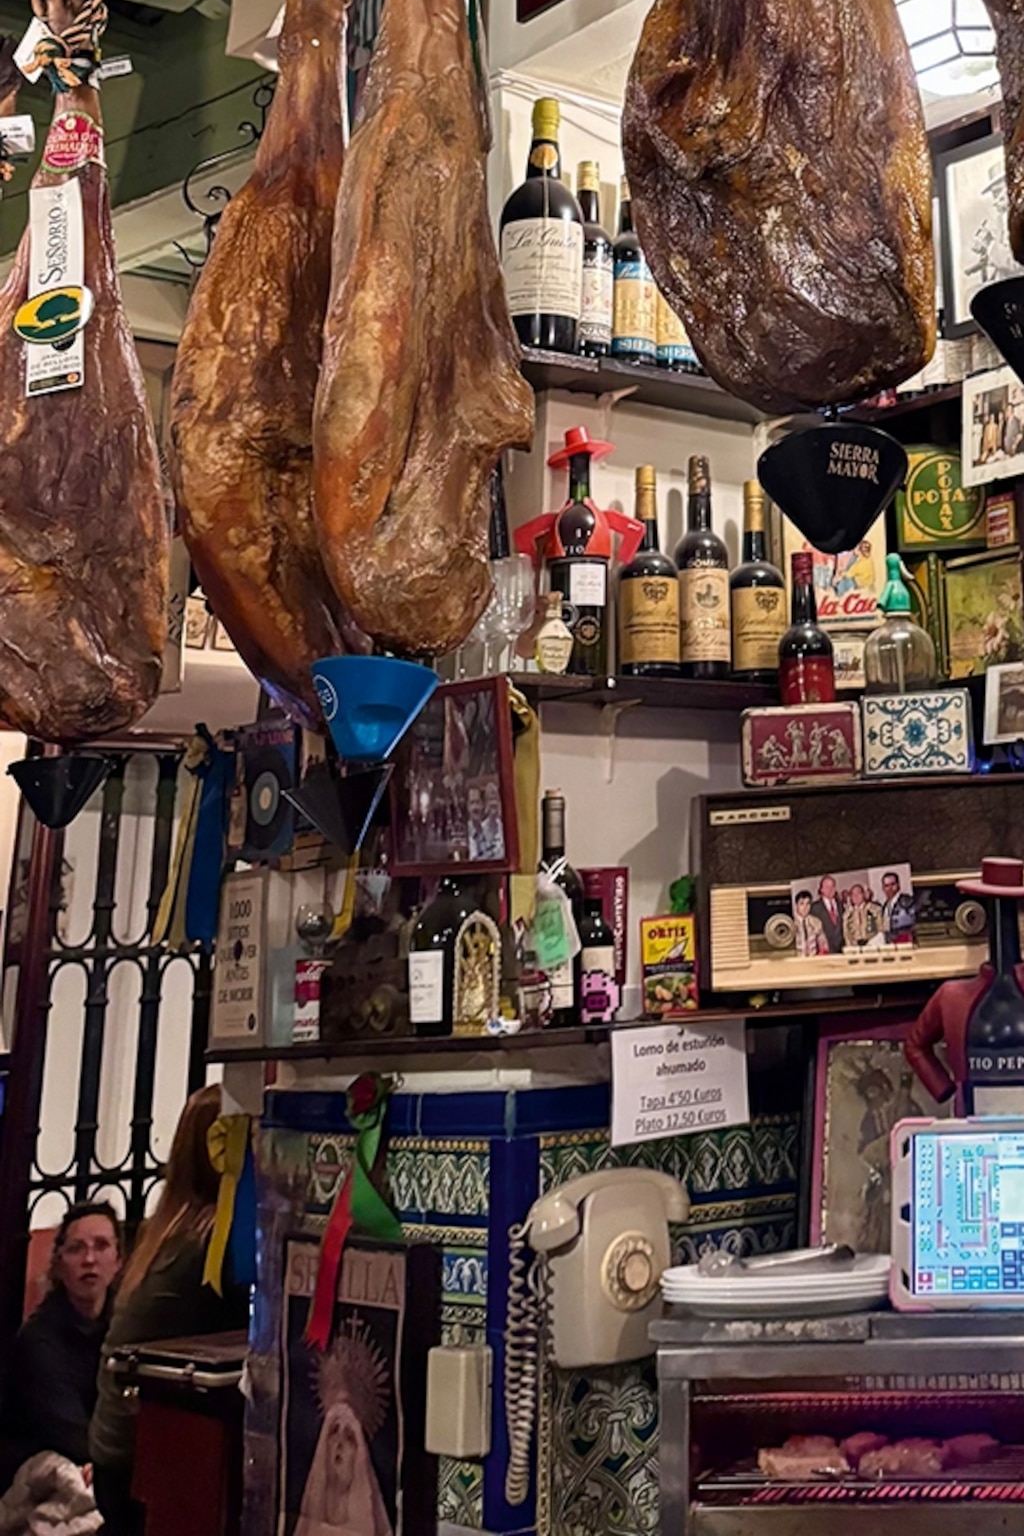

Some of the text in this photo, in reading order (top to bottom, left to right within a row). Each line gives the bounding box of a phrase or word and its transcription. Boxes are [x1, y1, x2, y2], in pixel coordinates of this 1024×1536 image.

[829, 441, 880, 464] SIERRA
[826, 460, 879, 485] MAYOR
[648, 925, 687, 940] ORTIZ
[633, 1034, 725, 1058] Lomo de esturión
[656, 1058, 706, 1077] ahumado
[968, 1056, 993, 1071] TIO
[640, 1095, 666, 1111] Tapa
[635, 1116, 663, 1133] Plato
